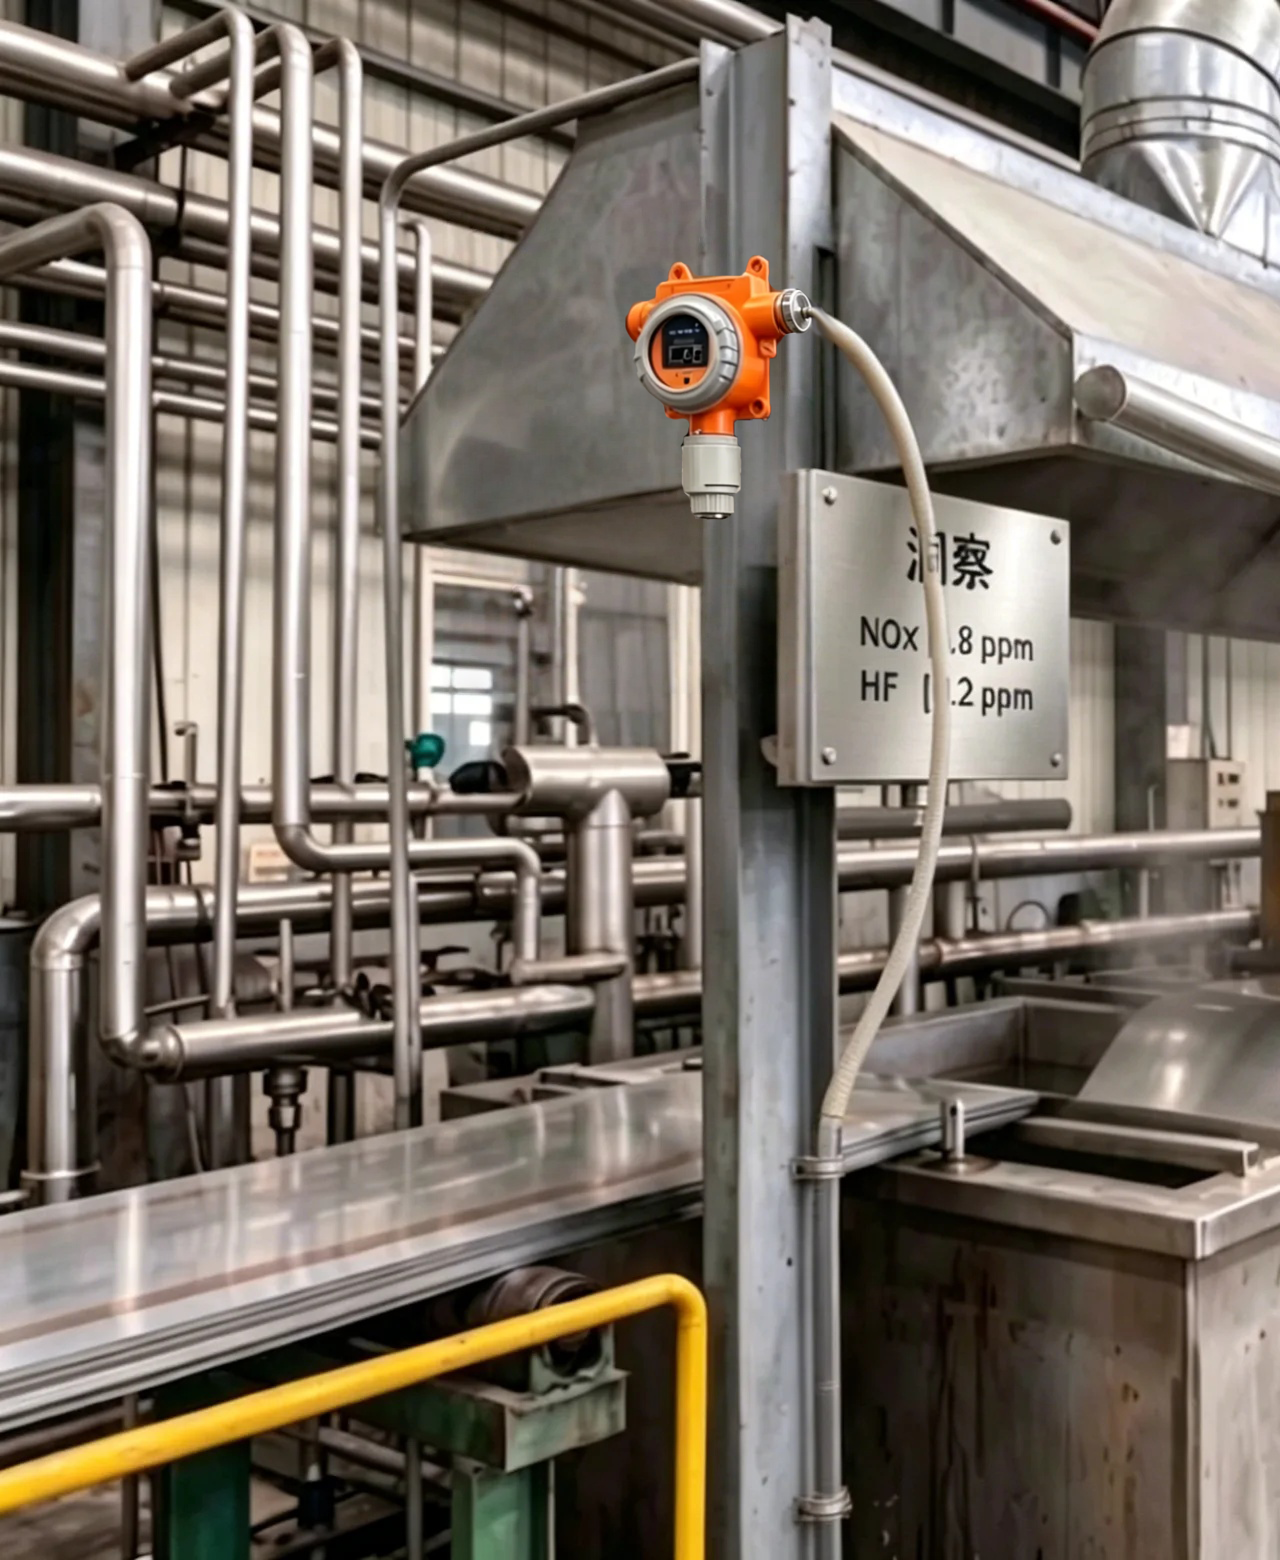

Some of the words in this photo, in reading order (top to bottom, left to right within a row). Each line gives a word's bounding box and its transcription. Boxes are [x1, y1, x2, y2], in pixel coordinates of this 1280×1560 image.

[861, 616, 919, 652] NOx
[981, 635, 1034, 664] ppm
[861, 669, 898, 701] HF
[981, 686, 1034, 717] ppm
